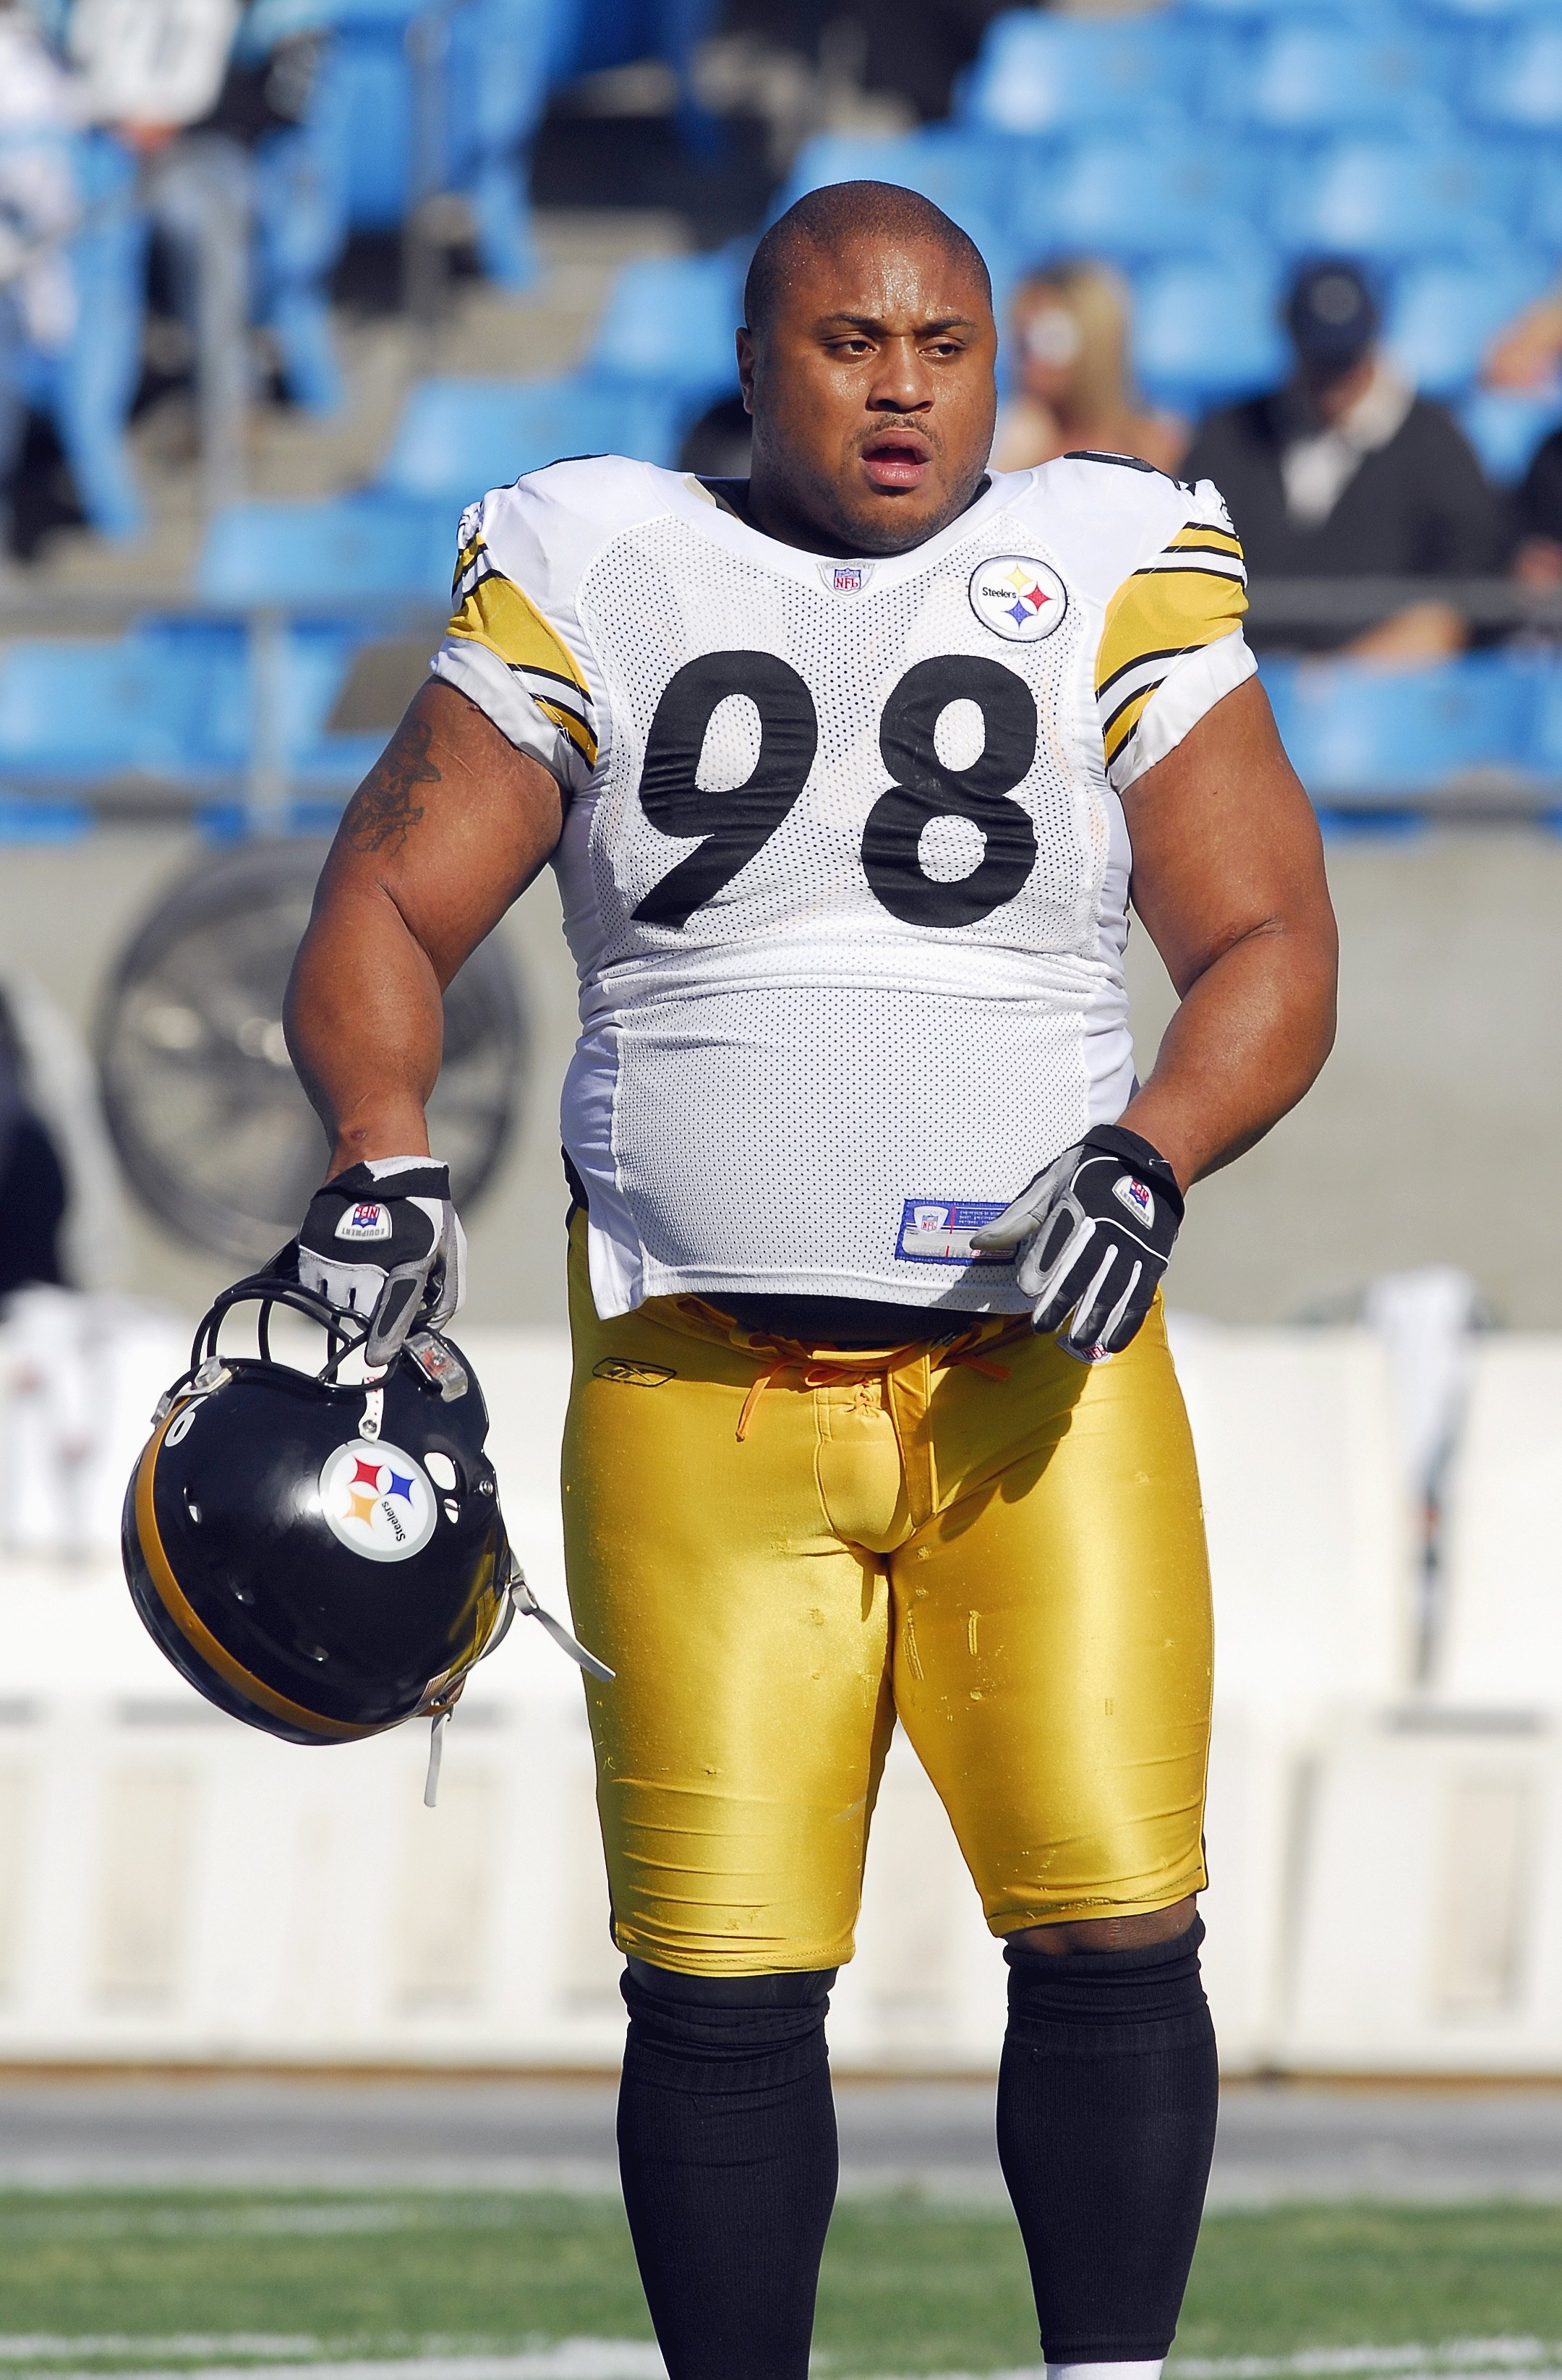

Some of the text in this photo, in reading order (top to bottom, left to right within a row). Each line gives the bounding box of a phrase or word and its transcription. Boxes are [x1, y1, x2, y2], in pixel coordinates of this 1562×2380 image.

[836, 577, 858, 589] NFL
[982, 587, 1017, 599] Steelers
[631, 649, 1038, 929] 98
[356, 1205, 379, 1219] NFL
[341, 1227, 385, 1237] EQUIPMENT
[923, 1221, 937, 1232] NFL
[382, 1501, 406, 1542] Steelers
